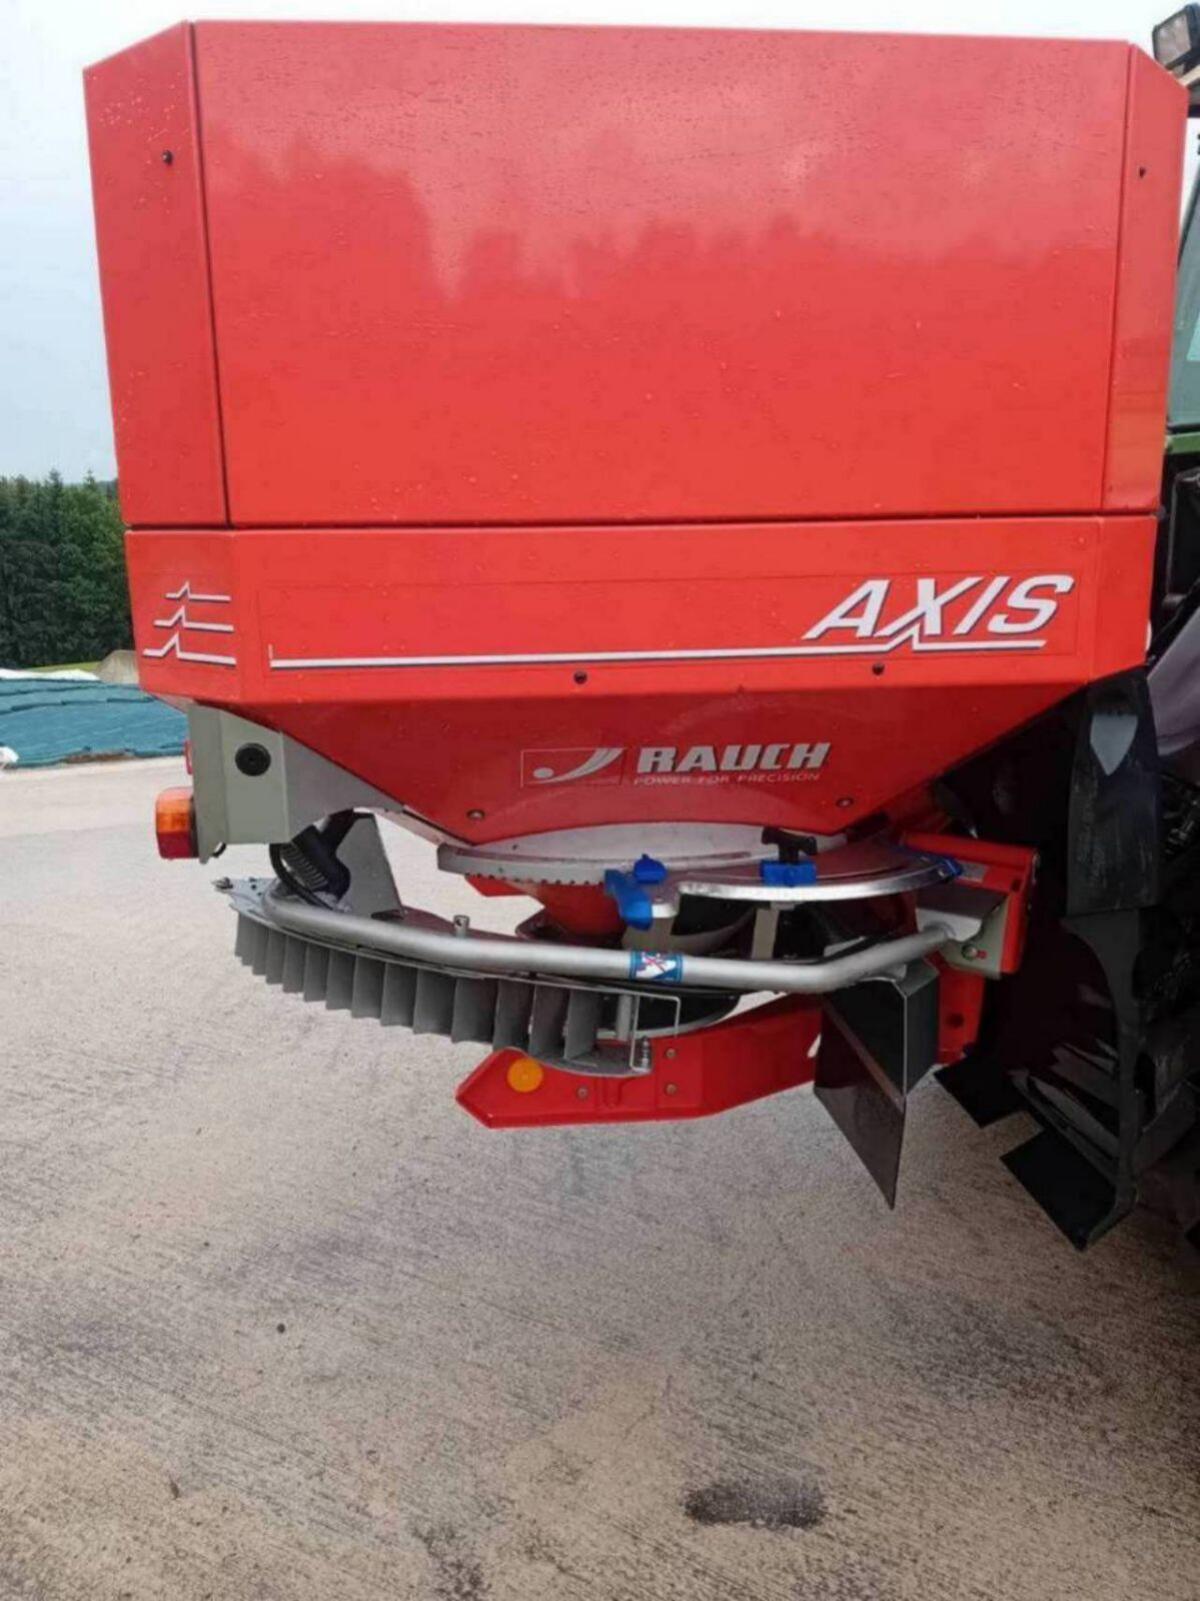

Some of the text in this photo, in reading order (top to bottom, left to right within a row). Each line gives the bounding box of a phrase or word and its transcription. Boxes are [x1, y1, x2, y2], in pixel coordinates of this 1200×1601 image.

[801, 574, 1075, 640] AXIS
[636, 742, 831, 773] RAUCH
[633, 773, 821, 785] POWER FOR PRECISION
